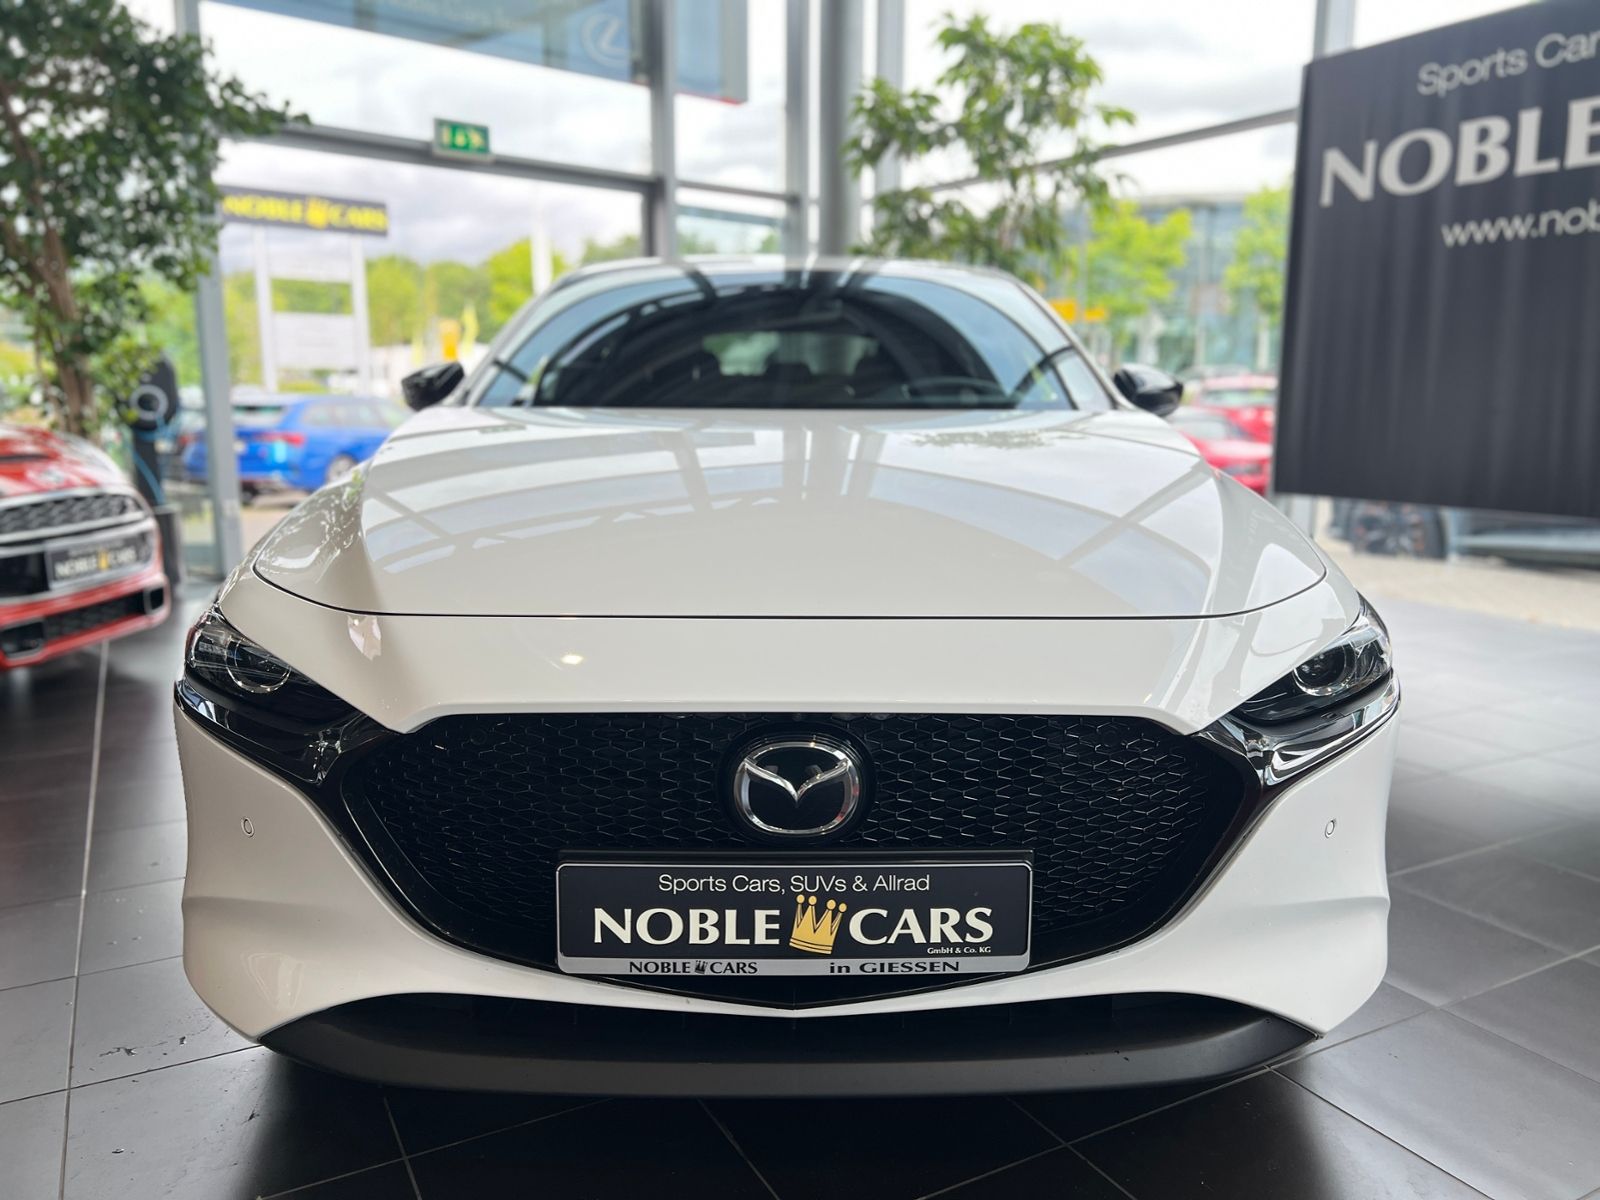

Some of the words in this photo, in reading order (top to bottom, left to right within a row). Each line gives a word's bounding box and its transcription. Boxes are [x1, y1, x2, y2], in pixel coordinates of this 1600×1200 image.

[1416, 47, 1529, 97] Sports
[1319, 95, 1600, 207] NOBLE
[658, 874, 727, 895] Sports
[732, 874, 786, 895] Cars,
[790, 875, 847, 892] SUVs
[852, 875, 868, 892] &
[873, 874, 930, 892] Allrad
[594, 907, 781, 945] NOBLE
[849, 907, 994, 945] CARS
[927, 946, 953, 955] GmbH
[963, 946, 977, 954] Co.
[979, 946, 992, 954] KG
[629, 961, 691, 974] NOBLE
[709, 961, 758, 975] CARS
[829, 962, 850, 974] in
[859, 961, 960, 974] GIESSEN
